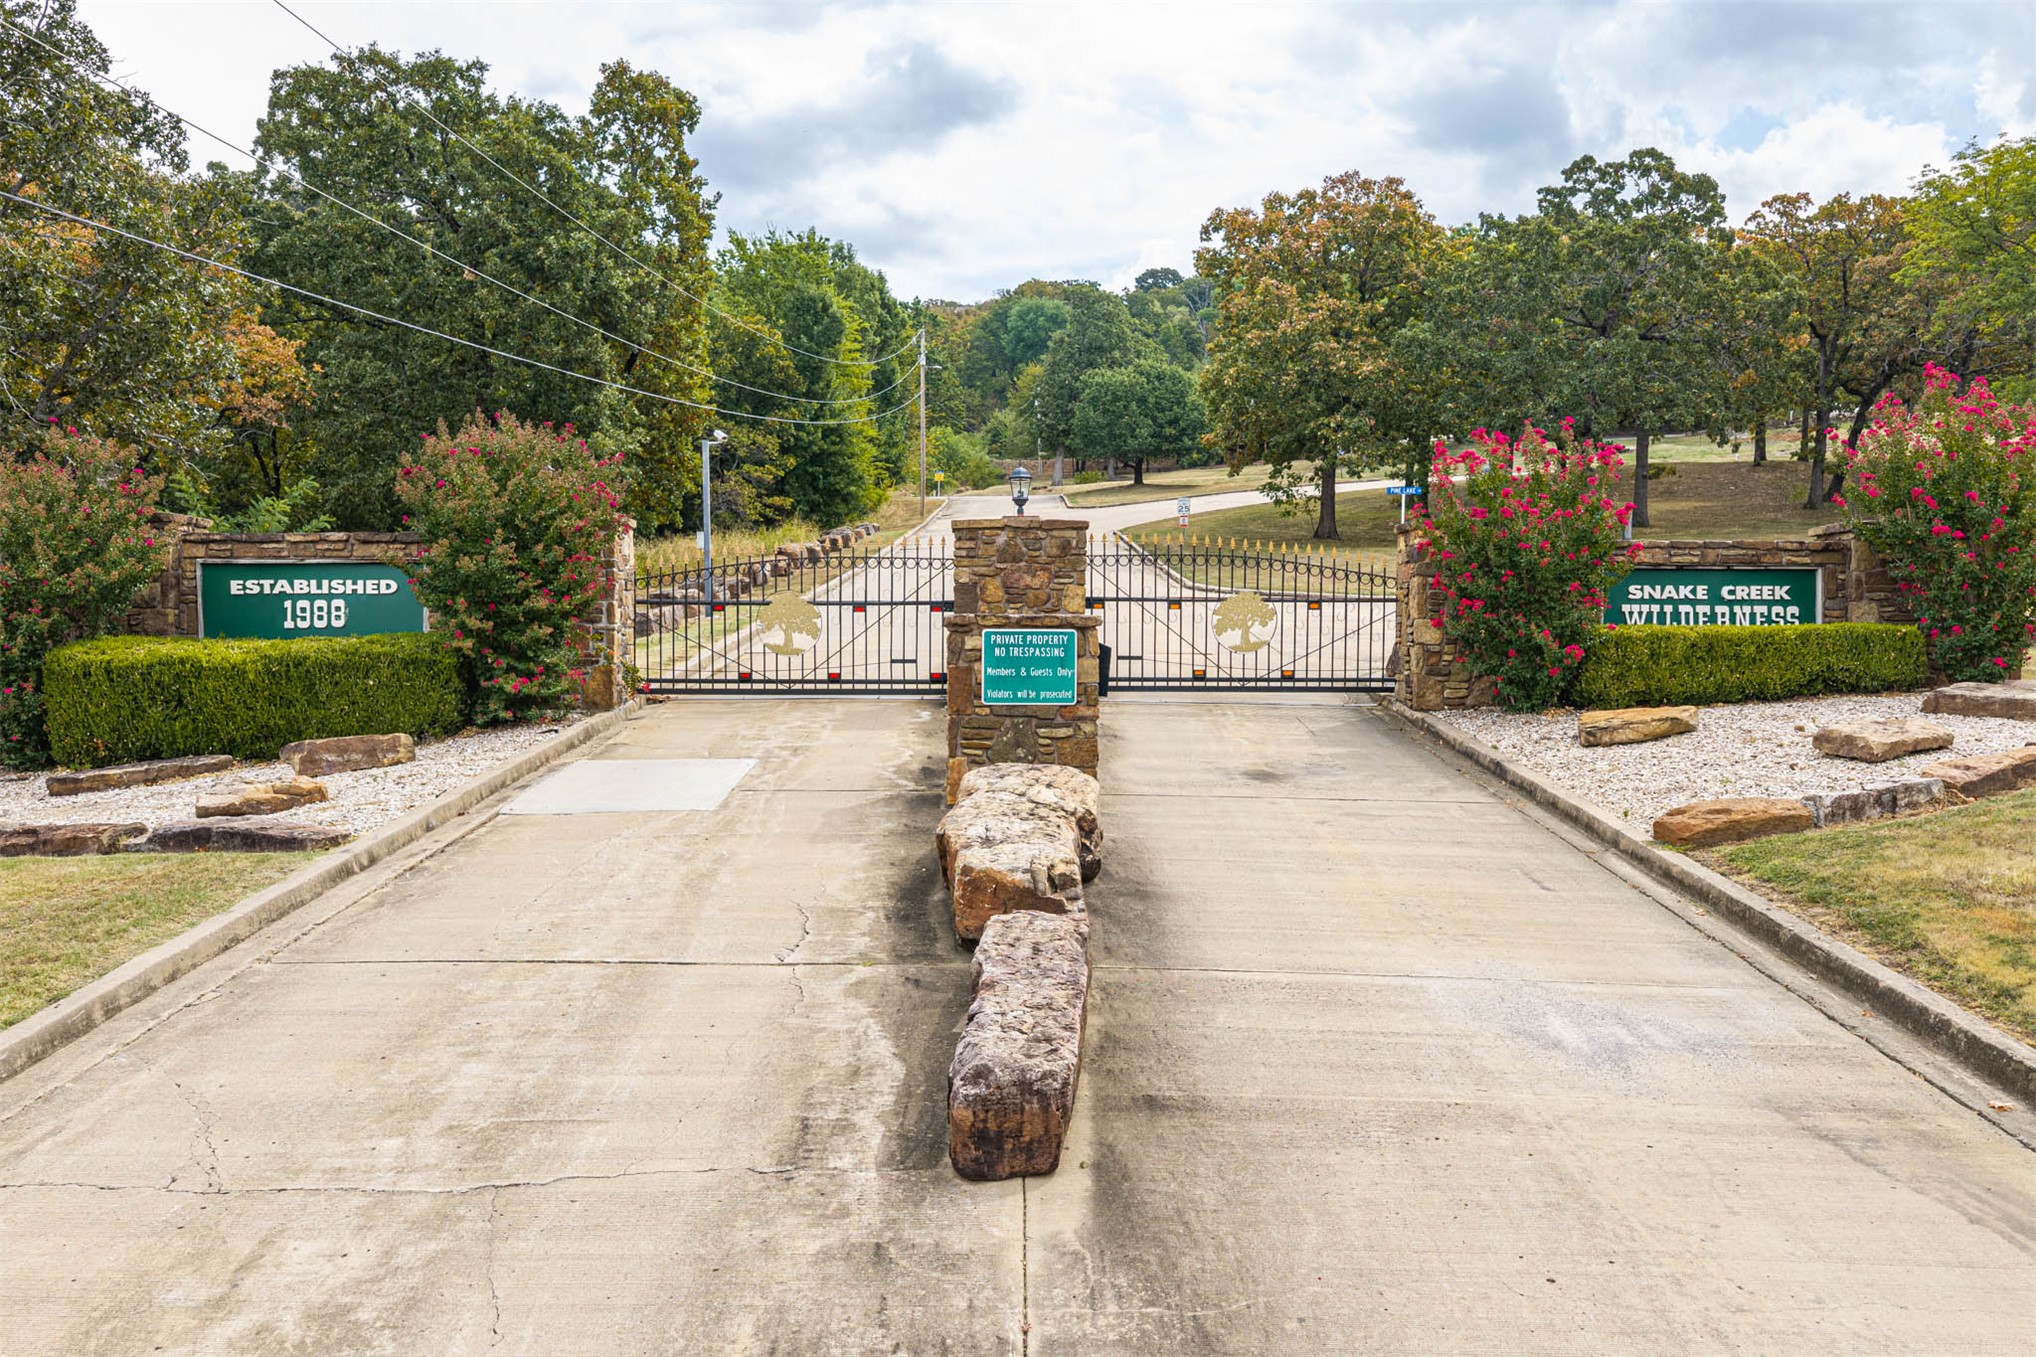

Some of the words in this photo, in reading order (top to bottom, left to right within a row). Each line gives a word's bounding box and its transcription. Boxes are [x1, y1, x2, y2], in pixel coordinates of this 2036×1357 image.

[1178, 505, 1190, 513] 25
[230, 579, 398, 595] ESTABLISHED
[1628, 585, 1709, 600] SNAKE
[1721, 584, 1791, 600] CREEK
[283, 599, 346, 629] 1988
[1621, 604, 1800, 626] WILDERNESS
[990, 635, 1023, 645] PRIVATE
[1026, 635, 1068, 645] PROPERTY
[994, 647, 1006, 657] NO
[1009, 647, 1065, 657] TRESPASSING
[986, 667, 1016, 677] Members
[1020, 666, 1027, 677] &
[1030, 667, 1053, 677] Guests
[1057, 667, 1072, 678] Only
[986, 689, 1013, 698] Violators
[1017, 689, 1028, 698] will
[1028, 690, 1036, 698] be
[1040, 690, 1072, 700] prosecuted
